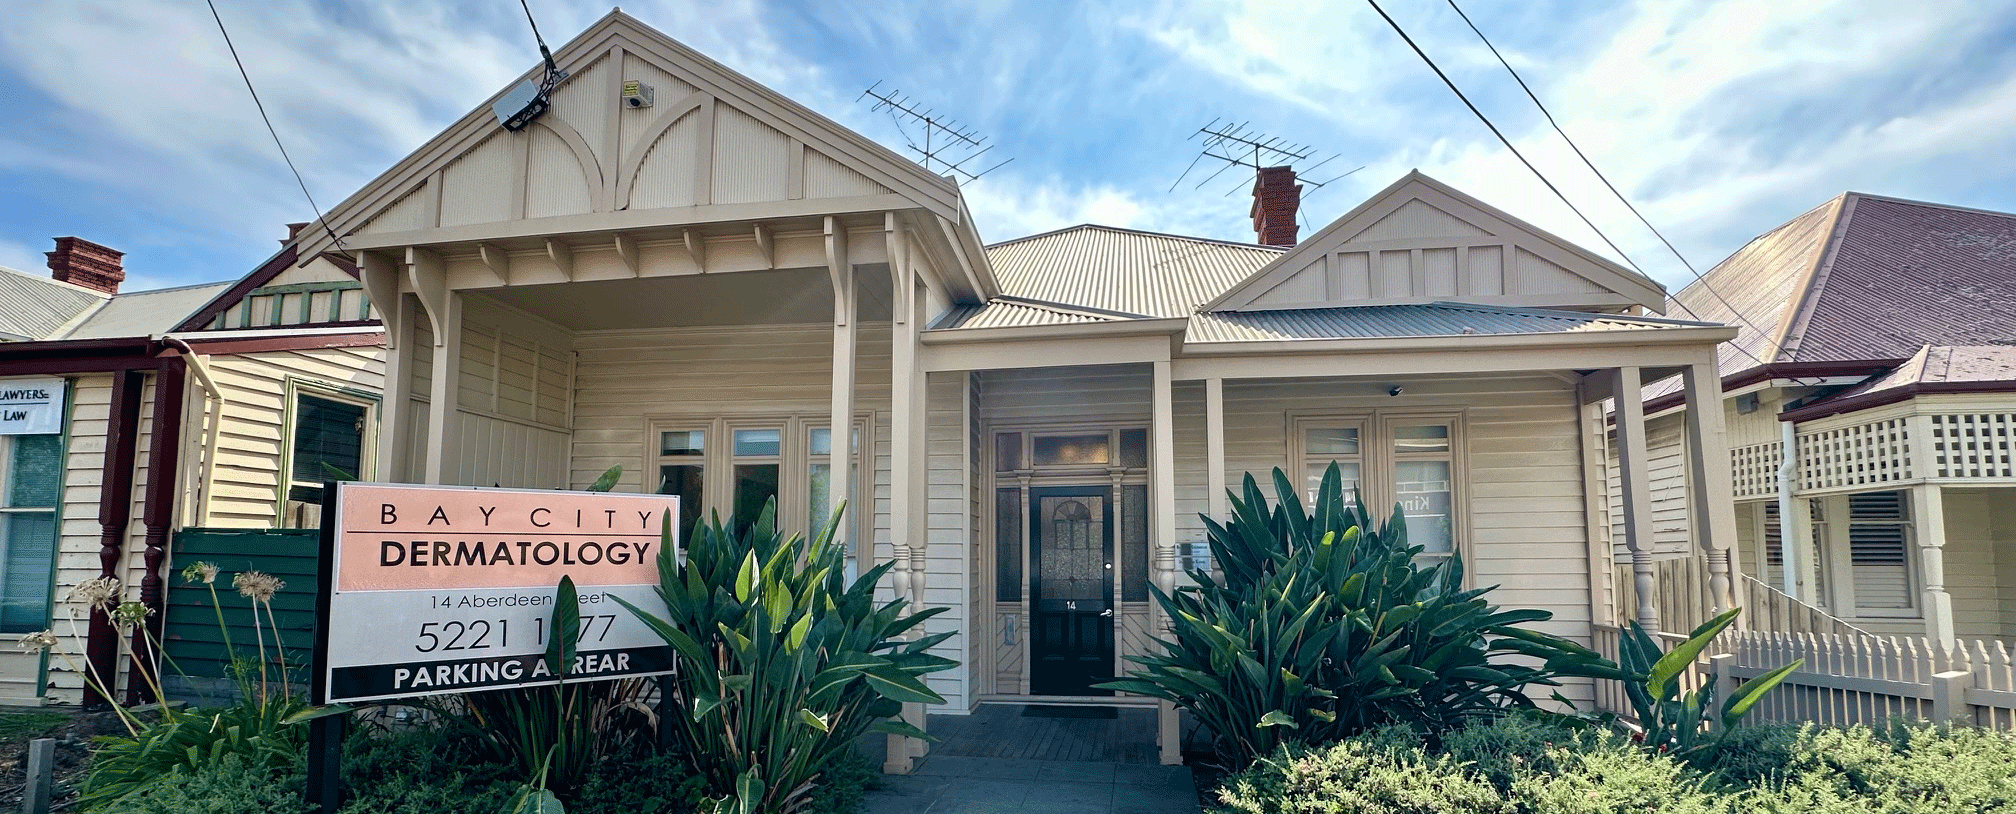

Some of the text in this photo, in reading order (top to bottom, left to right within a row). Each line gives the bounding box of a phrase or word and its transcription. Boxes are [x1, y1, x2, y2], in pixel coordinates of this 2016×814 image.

[380, 541, 650, 567] DERMATOLOGY
[431, 595, 451, 609] 14
[458, 593, 552, 609] Aberdeen
[1066, 600, 1077, 610] 14
[415, 614, 616, 653] 5221 177
[395, 660, 522, 688] PARKING
[571, 652, 630, 674] REAR
